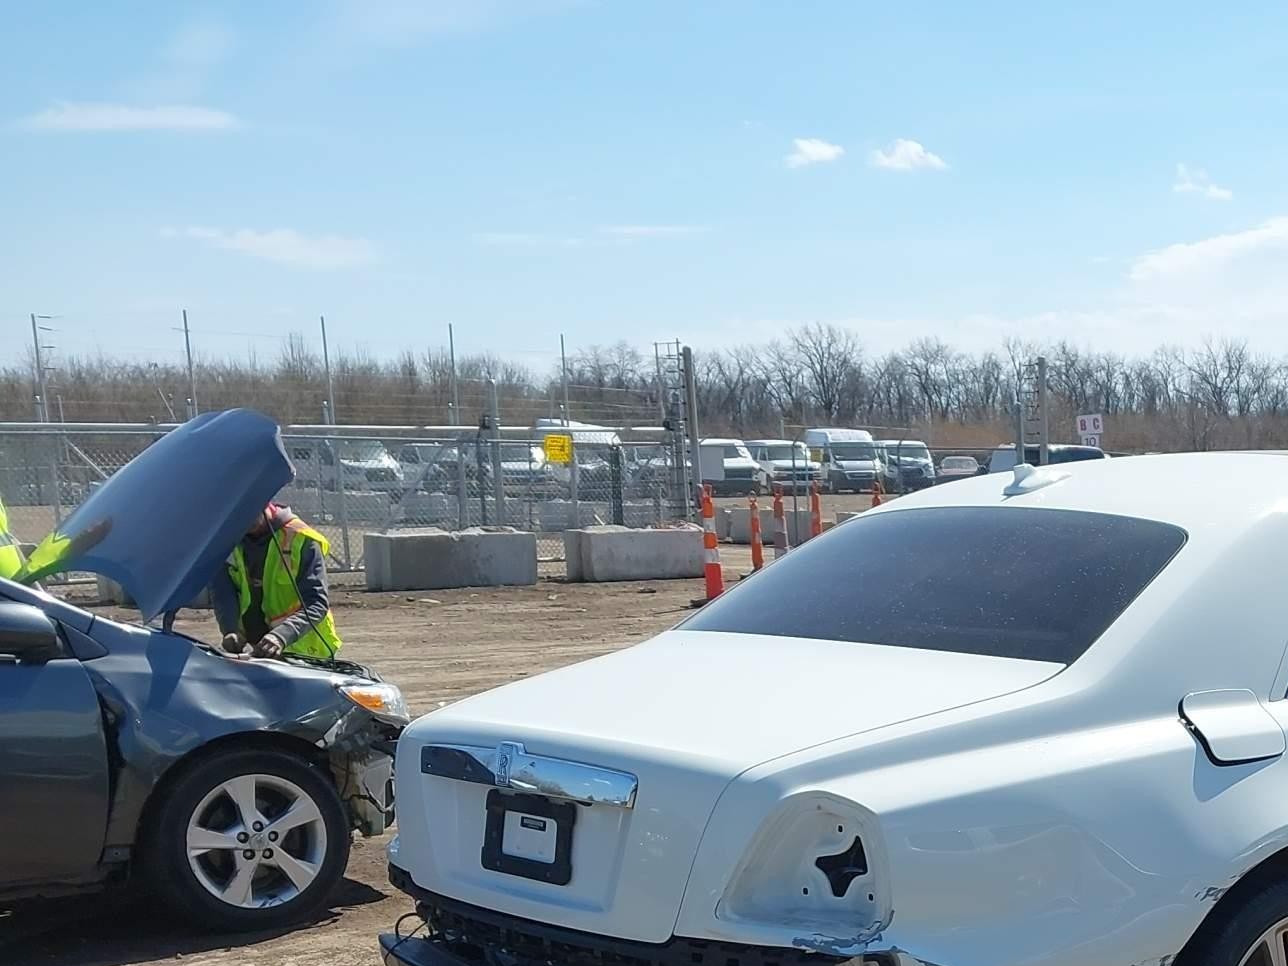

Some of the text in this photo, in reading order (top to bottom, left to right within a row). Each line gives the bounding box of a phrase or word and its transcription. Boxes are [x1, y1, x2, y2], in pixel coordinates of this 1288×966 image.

[1080, 417, 1100, 431] B C
[1085, 436, 1097, 447] 10
